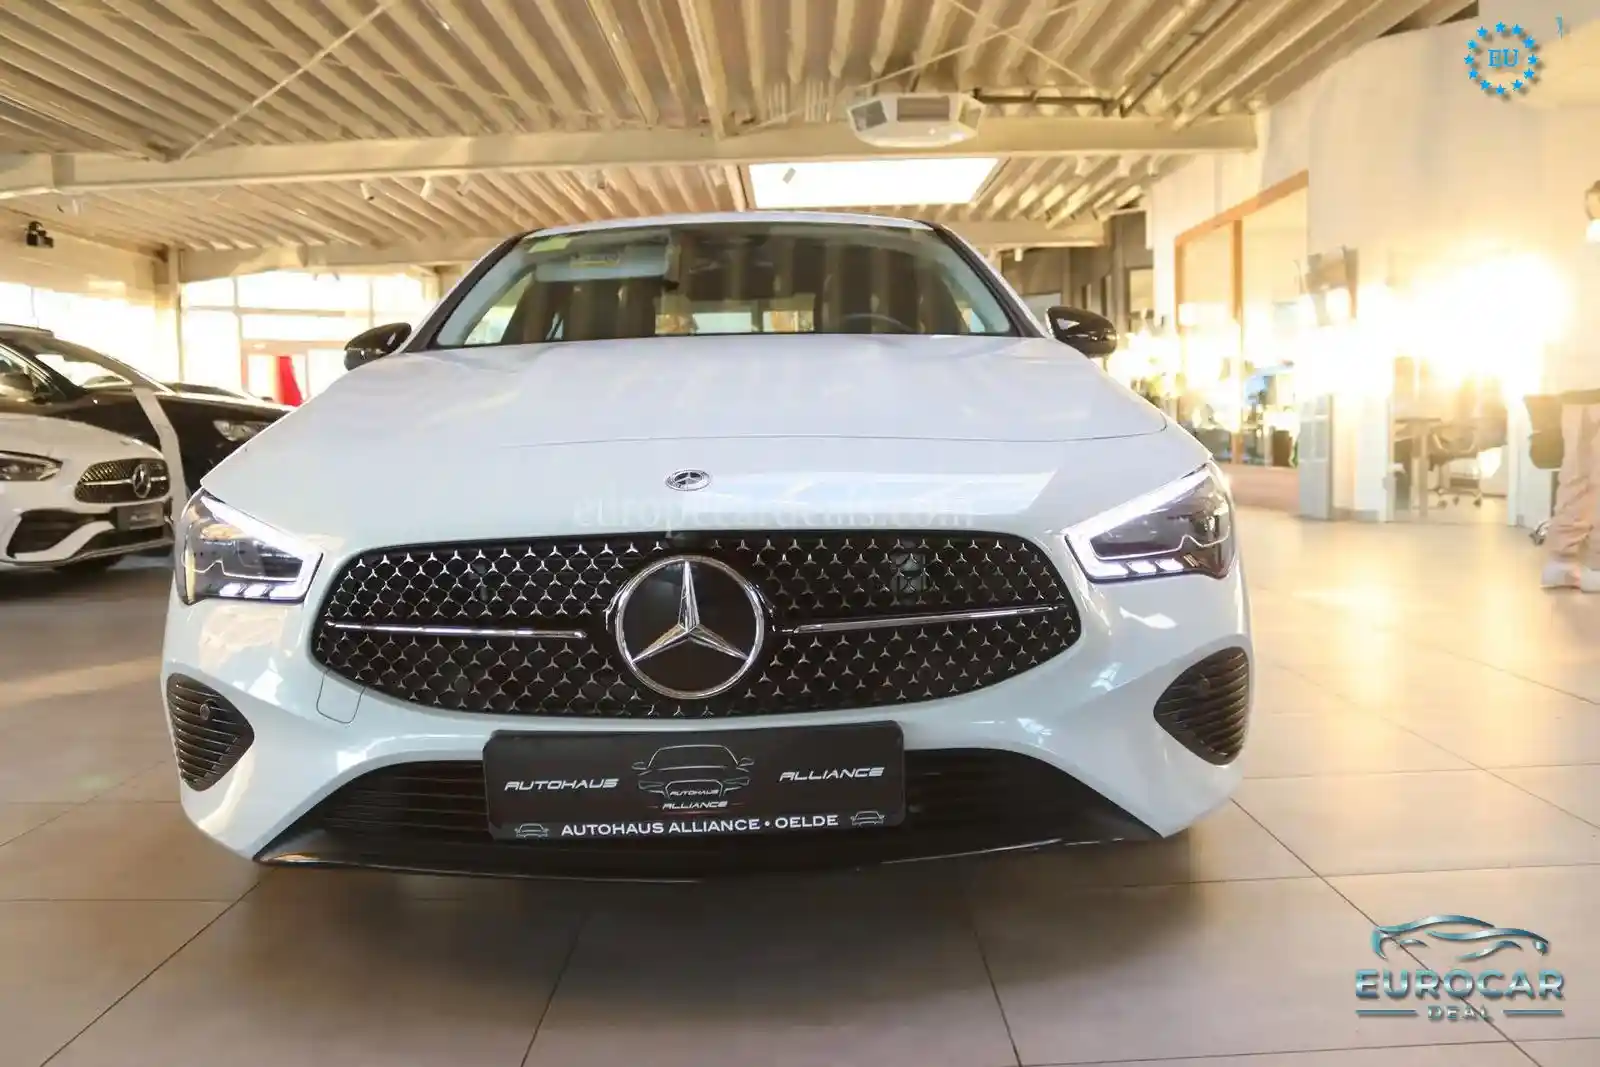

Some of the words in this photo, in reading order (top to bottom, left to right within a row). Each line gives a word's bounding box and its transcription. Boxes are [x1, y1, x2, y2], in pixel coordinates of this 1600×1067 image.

[779, 767, 885, 781] ALLIANCE
[504, 778, 619, 791] AUTOHAUS
[662, 800, 728, 810] ALLIANCE
[561, 822, 664, 836] AUTOHAUS
[668, 818, 760, 834] ALLIANCE
[775, 815, 839, 829] OELDE
